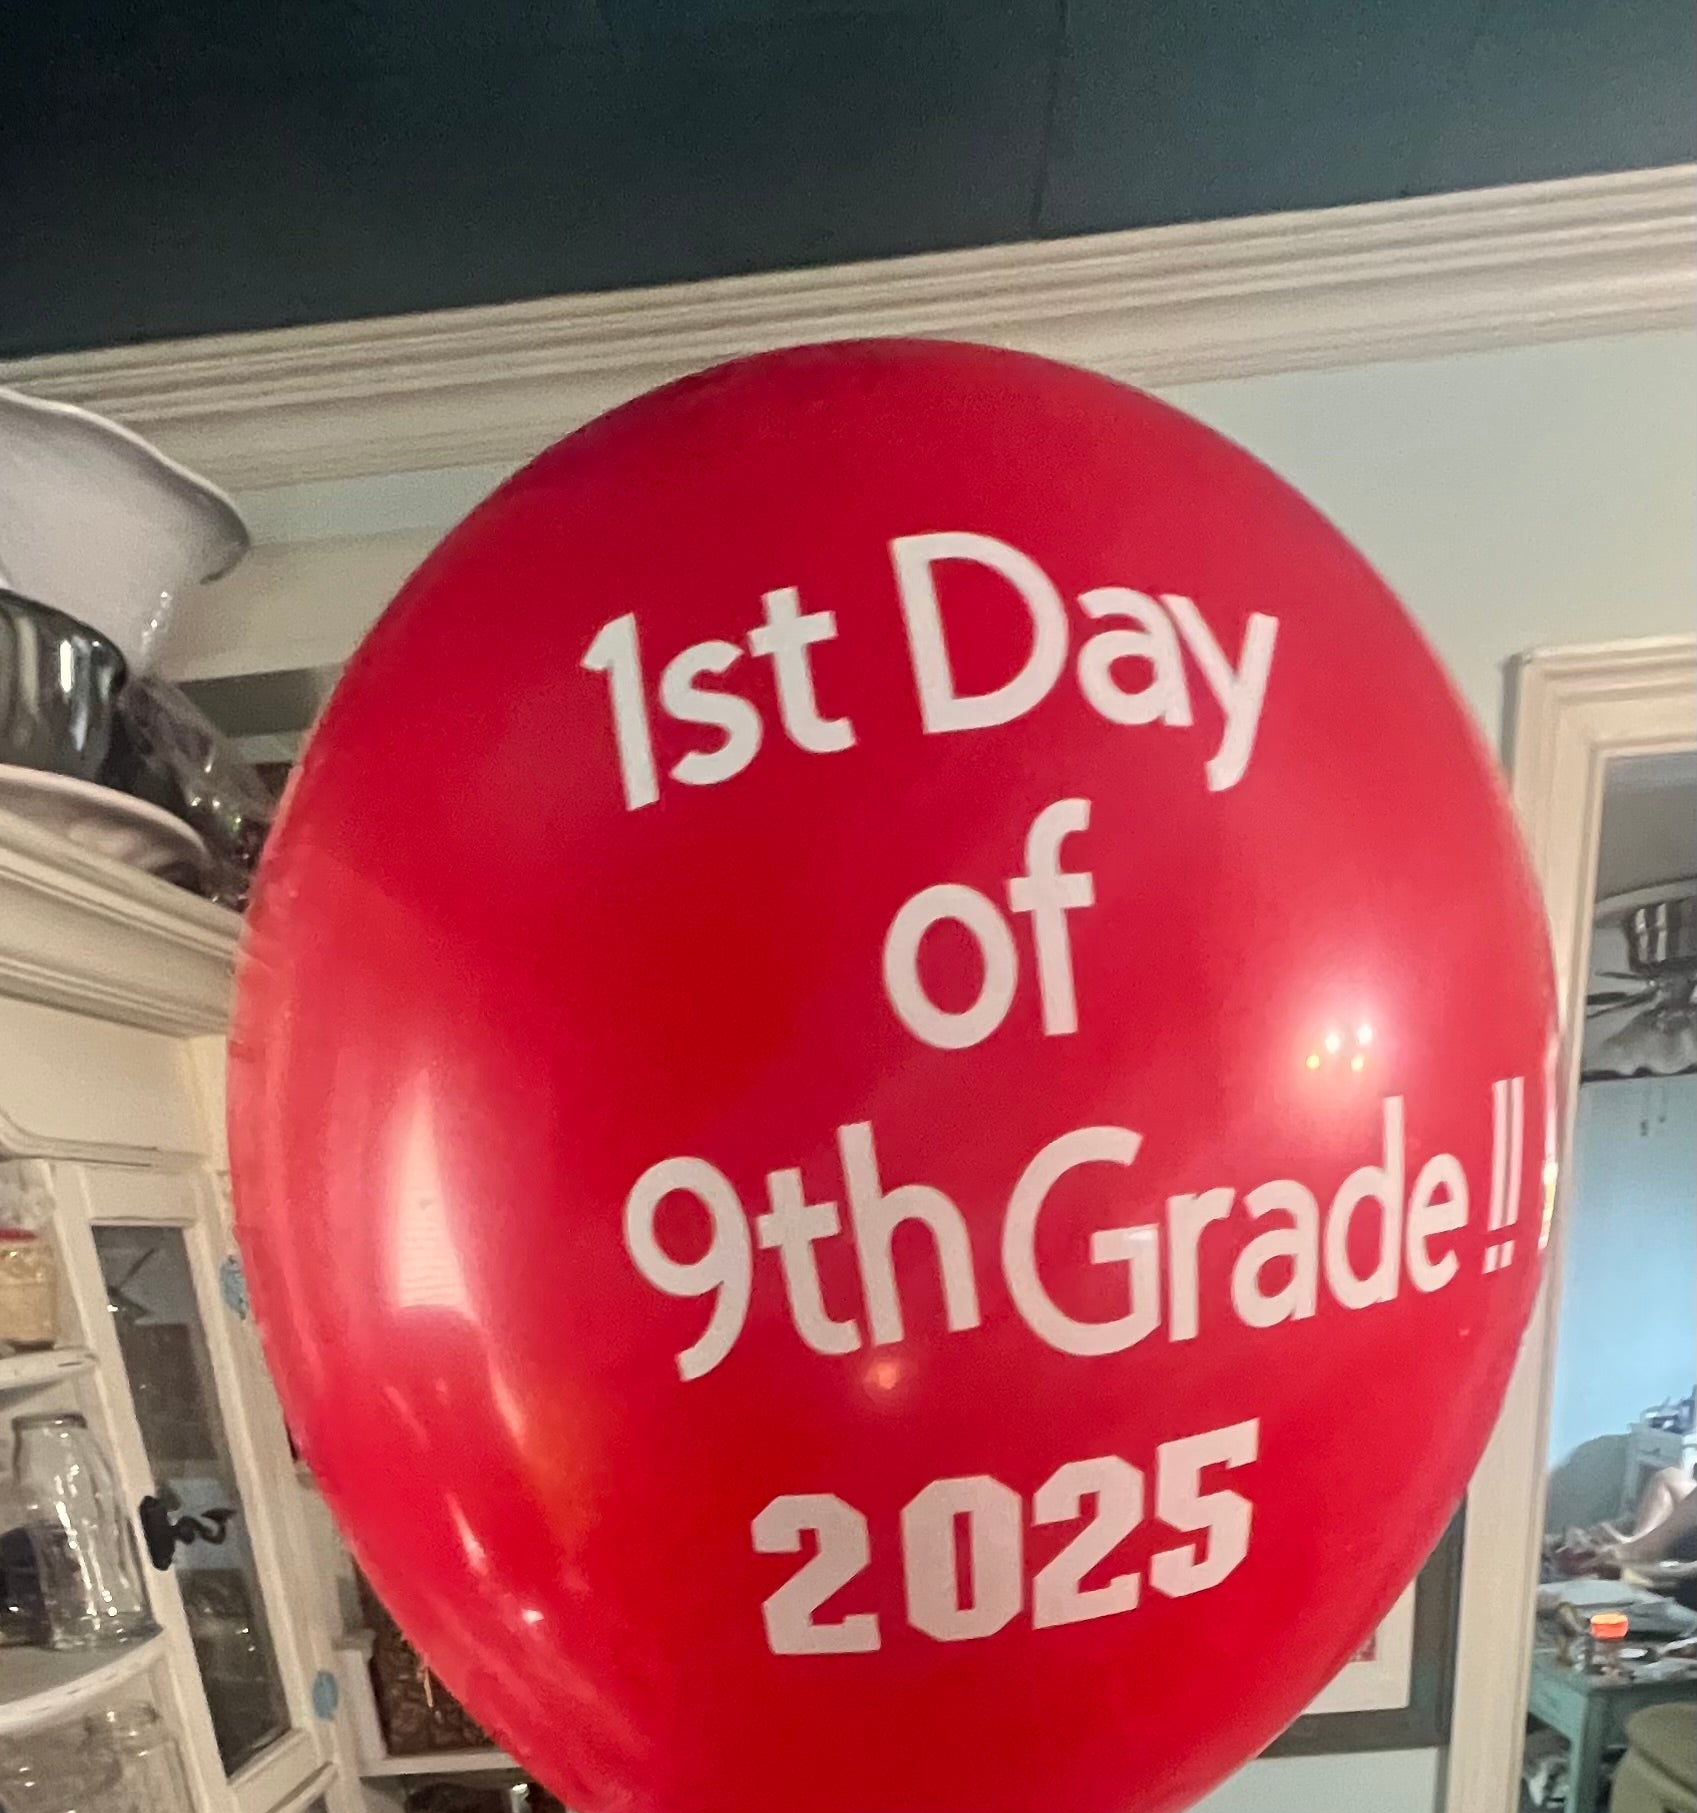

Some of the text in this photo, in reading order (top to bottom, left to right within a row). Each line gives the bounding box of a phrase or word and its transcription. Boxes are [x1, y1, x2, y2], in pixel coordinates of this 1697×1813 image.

[581, 531, 1279, 811] 1st Day
[883, 798, 1095, 1050] of
[624, 1120, 981, 1382] 9th
[751, 1418, 1260, 1656] 2025
